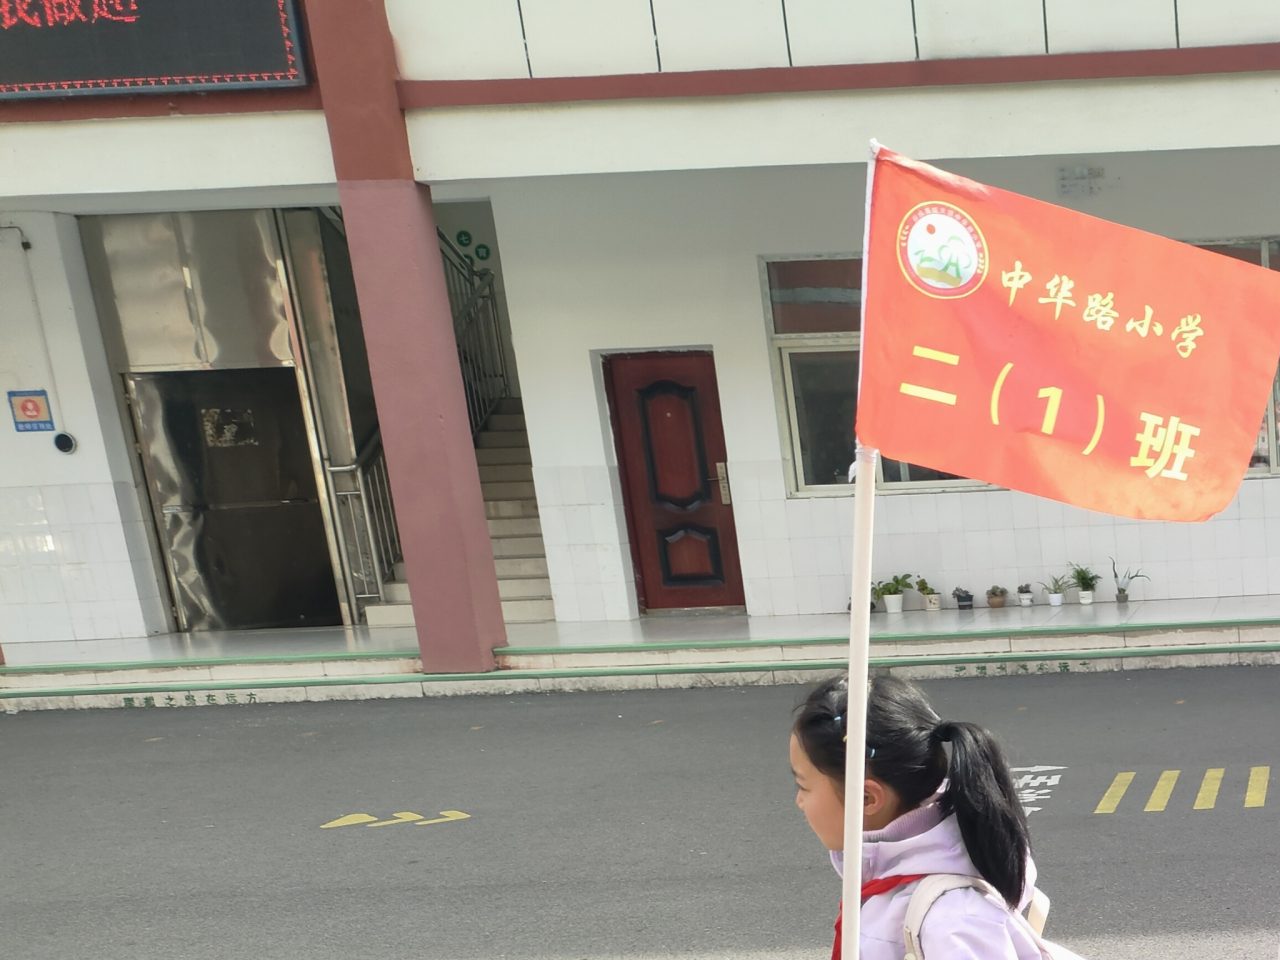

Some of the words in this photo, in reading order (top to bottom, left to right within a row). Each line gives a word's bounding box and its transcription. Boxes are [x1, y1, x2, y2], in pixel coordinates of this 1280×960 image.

[1001, 260, 1204, 358] 中华路小学
